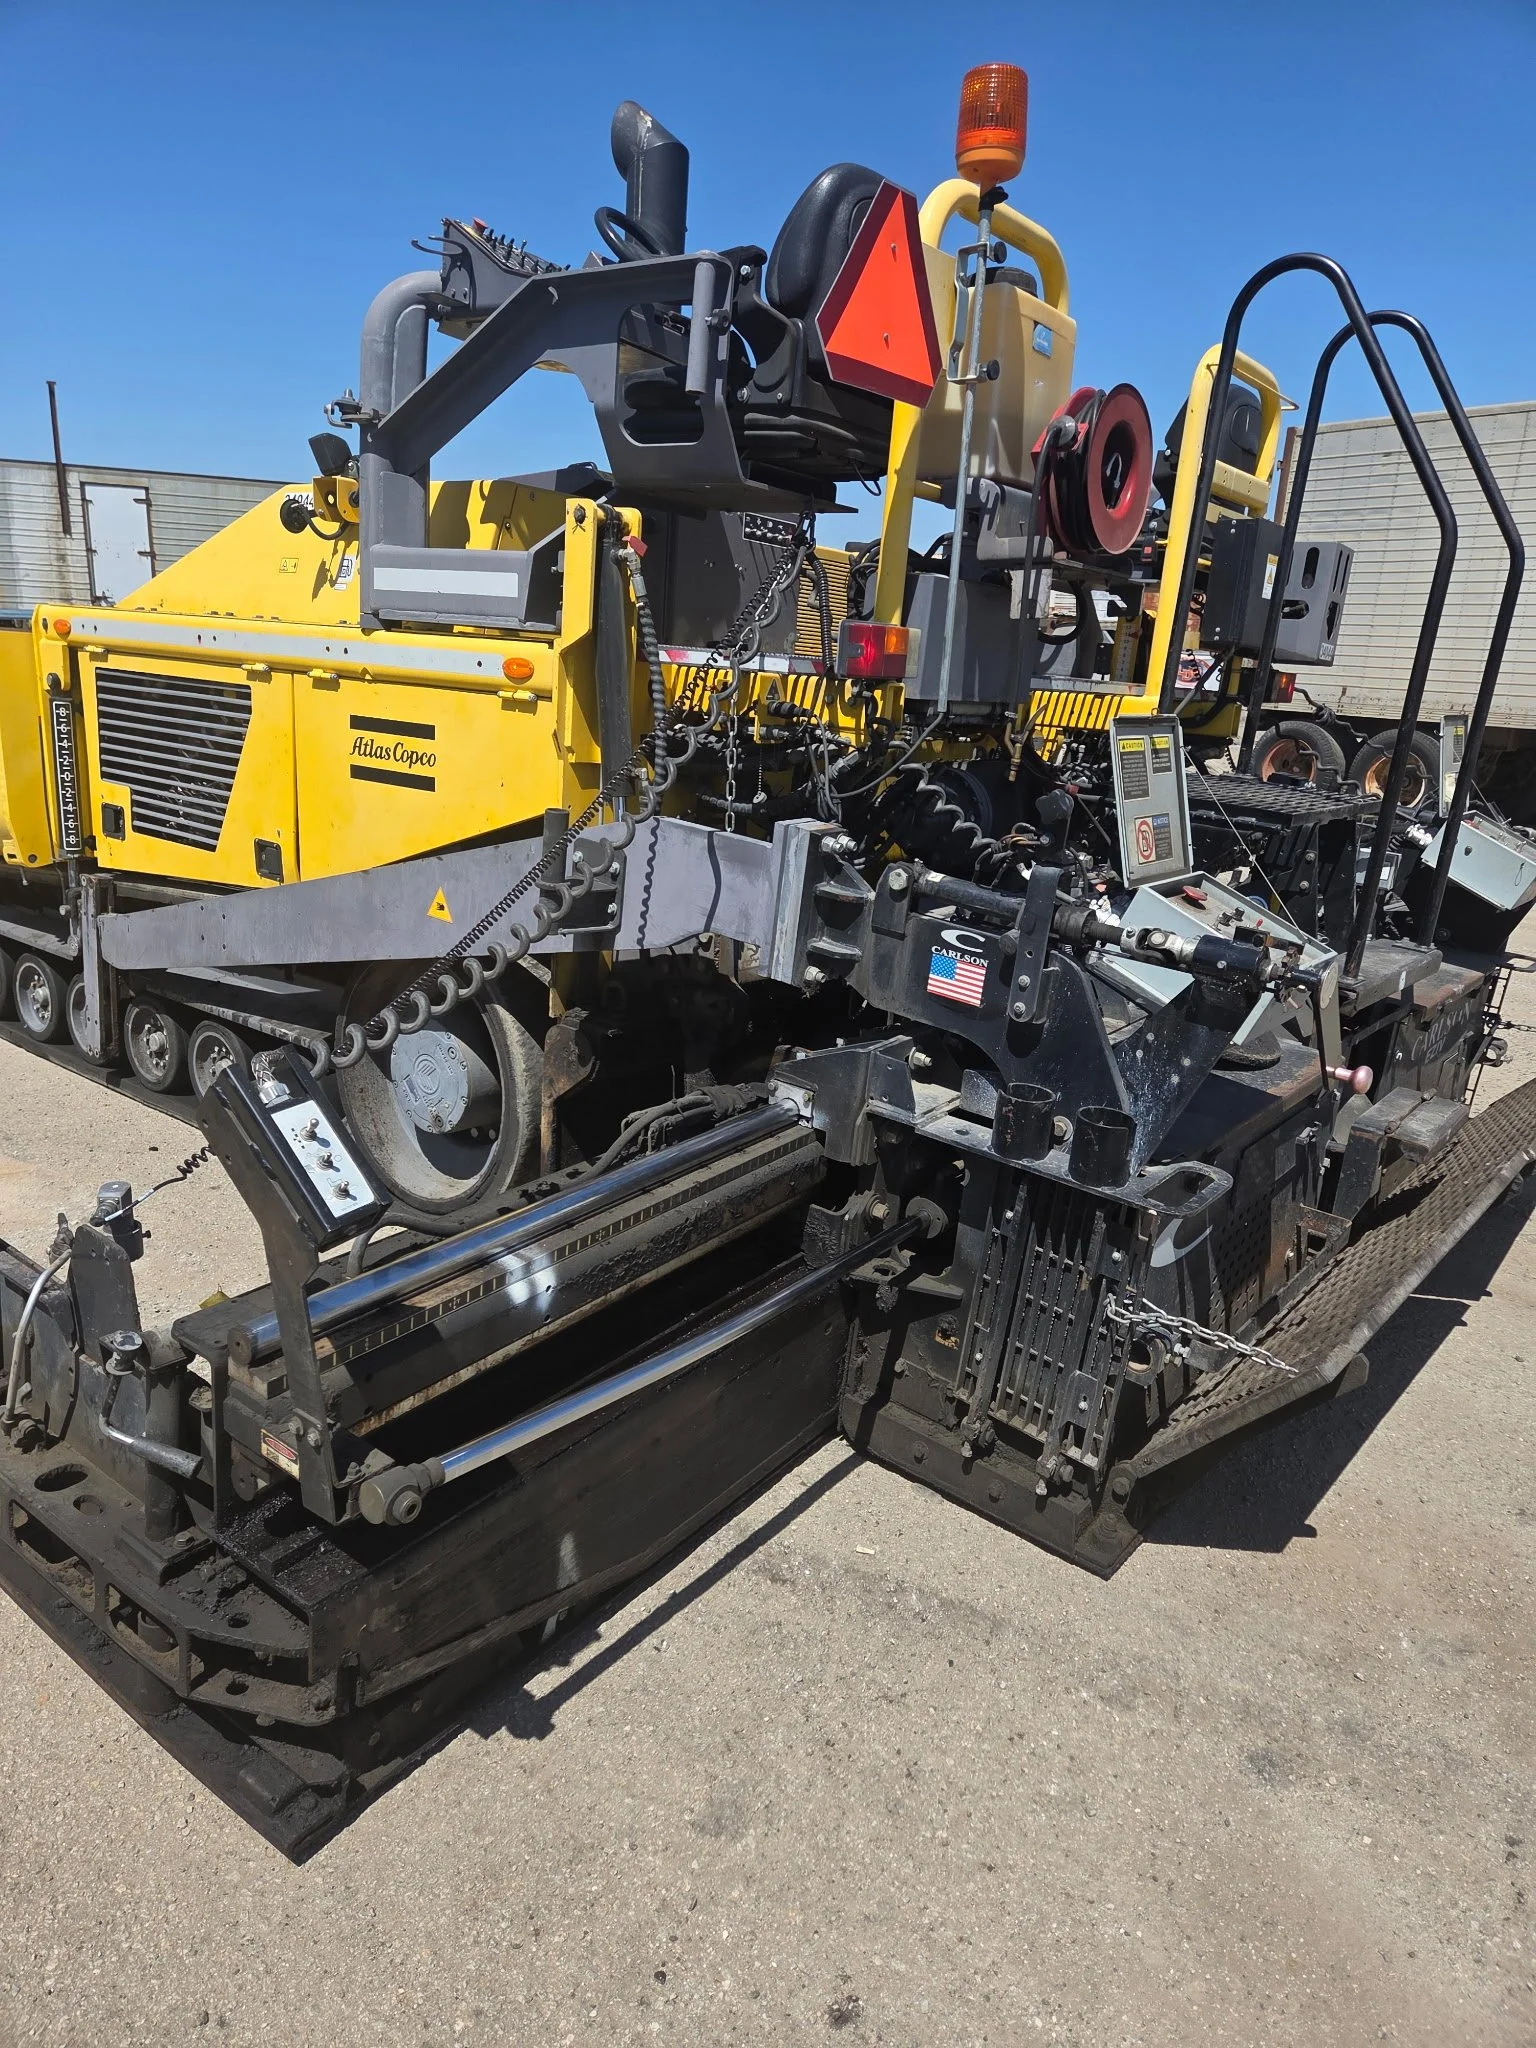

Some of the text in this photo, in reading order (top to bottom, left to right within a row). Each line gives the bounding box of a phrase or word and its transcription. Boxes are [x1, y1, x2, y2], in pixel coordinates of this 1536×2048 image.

[349, 736, 436, 769] Atlas Copco
[931, 945, 989, 968] CARLSON
